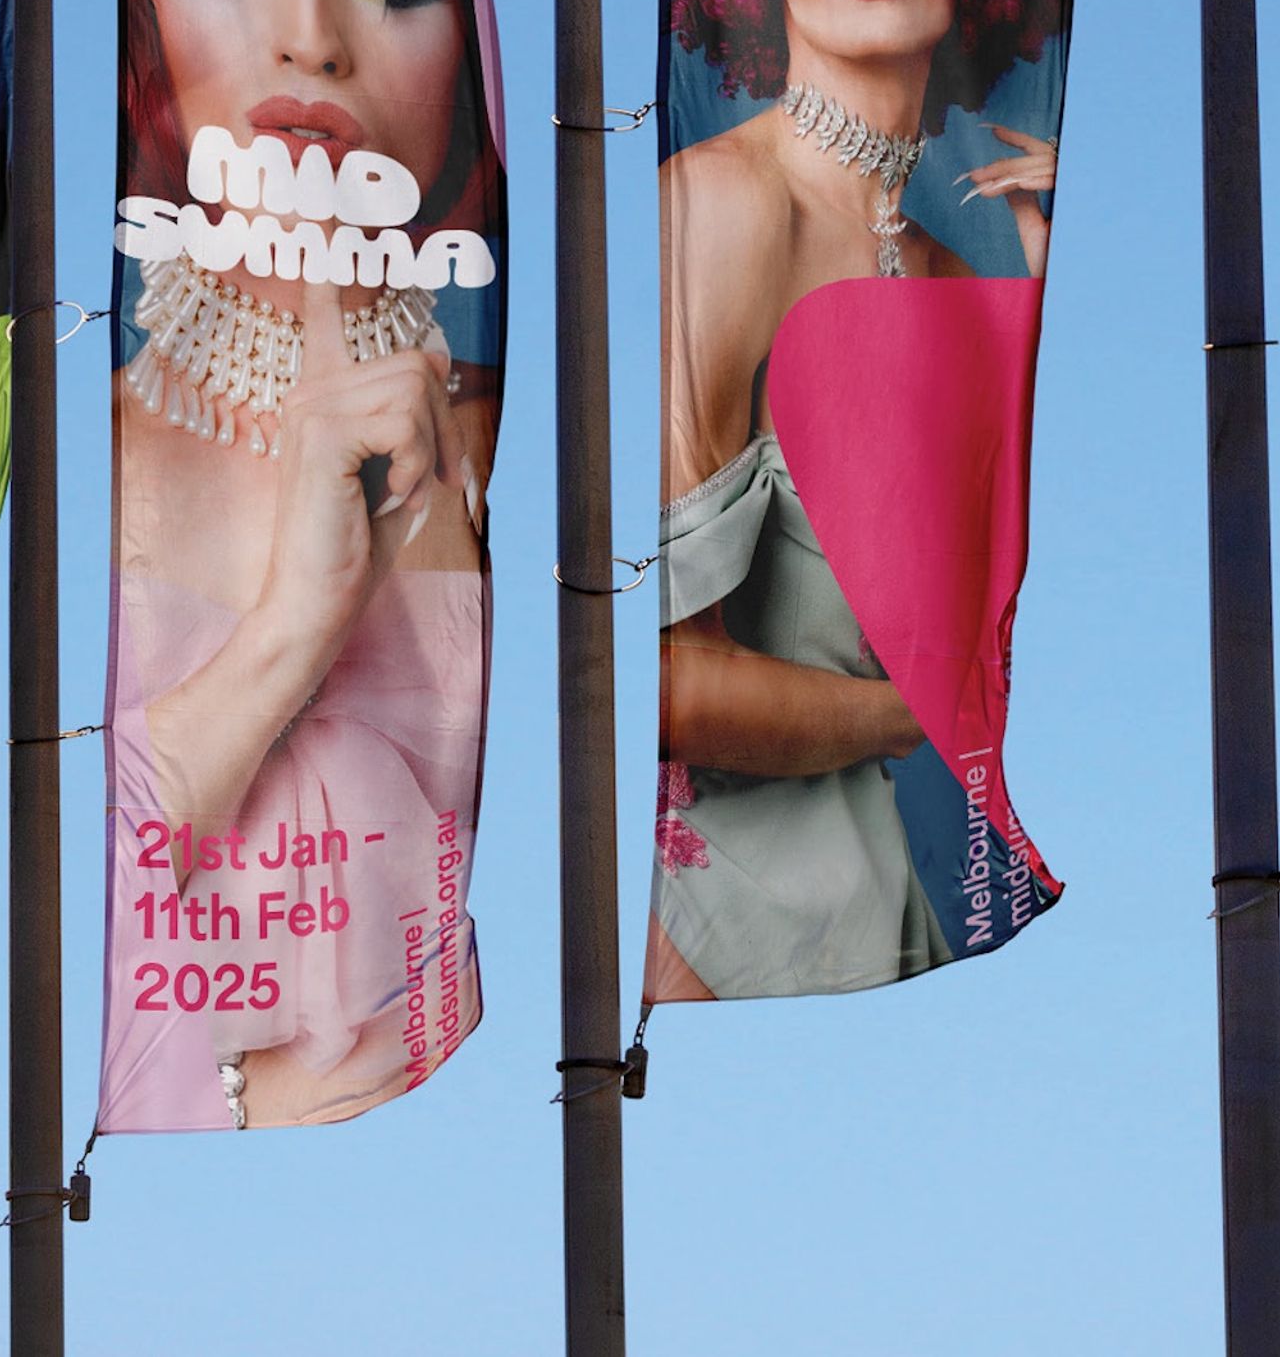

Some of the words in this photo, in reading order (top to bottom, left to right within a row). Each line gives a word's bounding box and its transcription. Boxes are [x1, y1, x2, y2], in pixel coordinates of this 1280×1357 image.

[187, 125, 420, 227] MID
[114, 195, 496, 290] SUMMA
[135, 820, 246, 871] 21st
[259, 823, 348, 870] Jan
[963, 765, 993, 946] Melbourne
[133, 892, 241, 941] 11th
[258, 887, 350, 939] Feb
[134, 962, 281, 1013] 2025
[403, 925, 428, 1092] Melbourne
